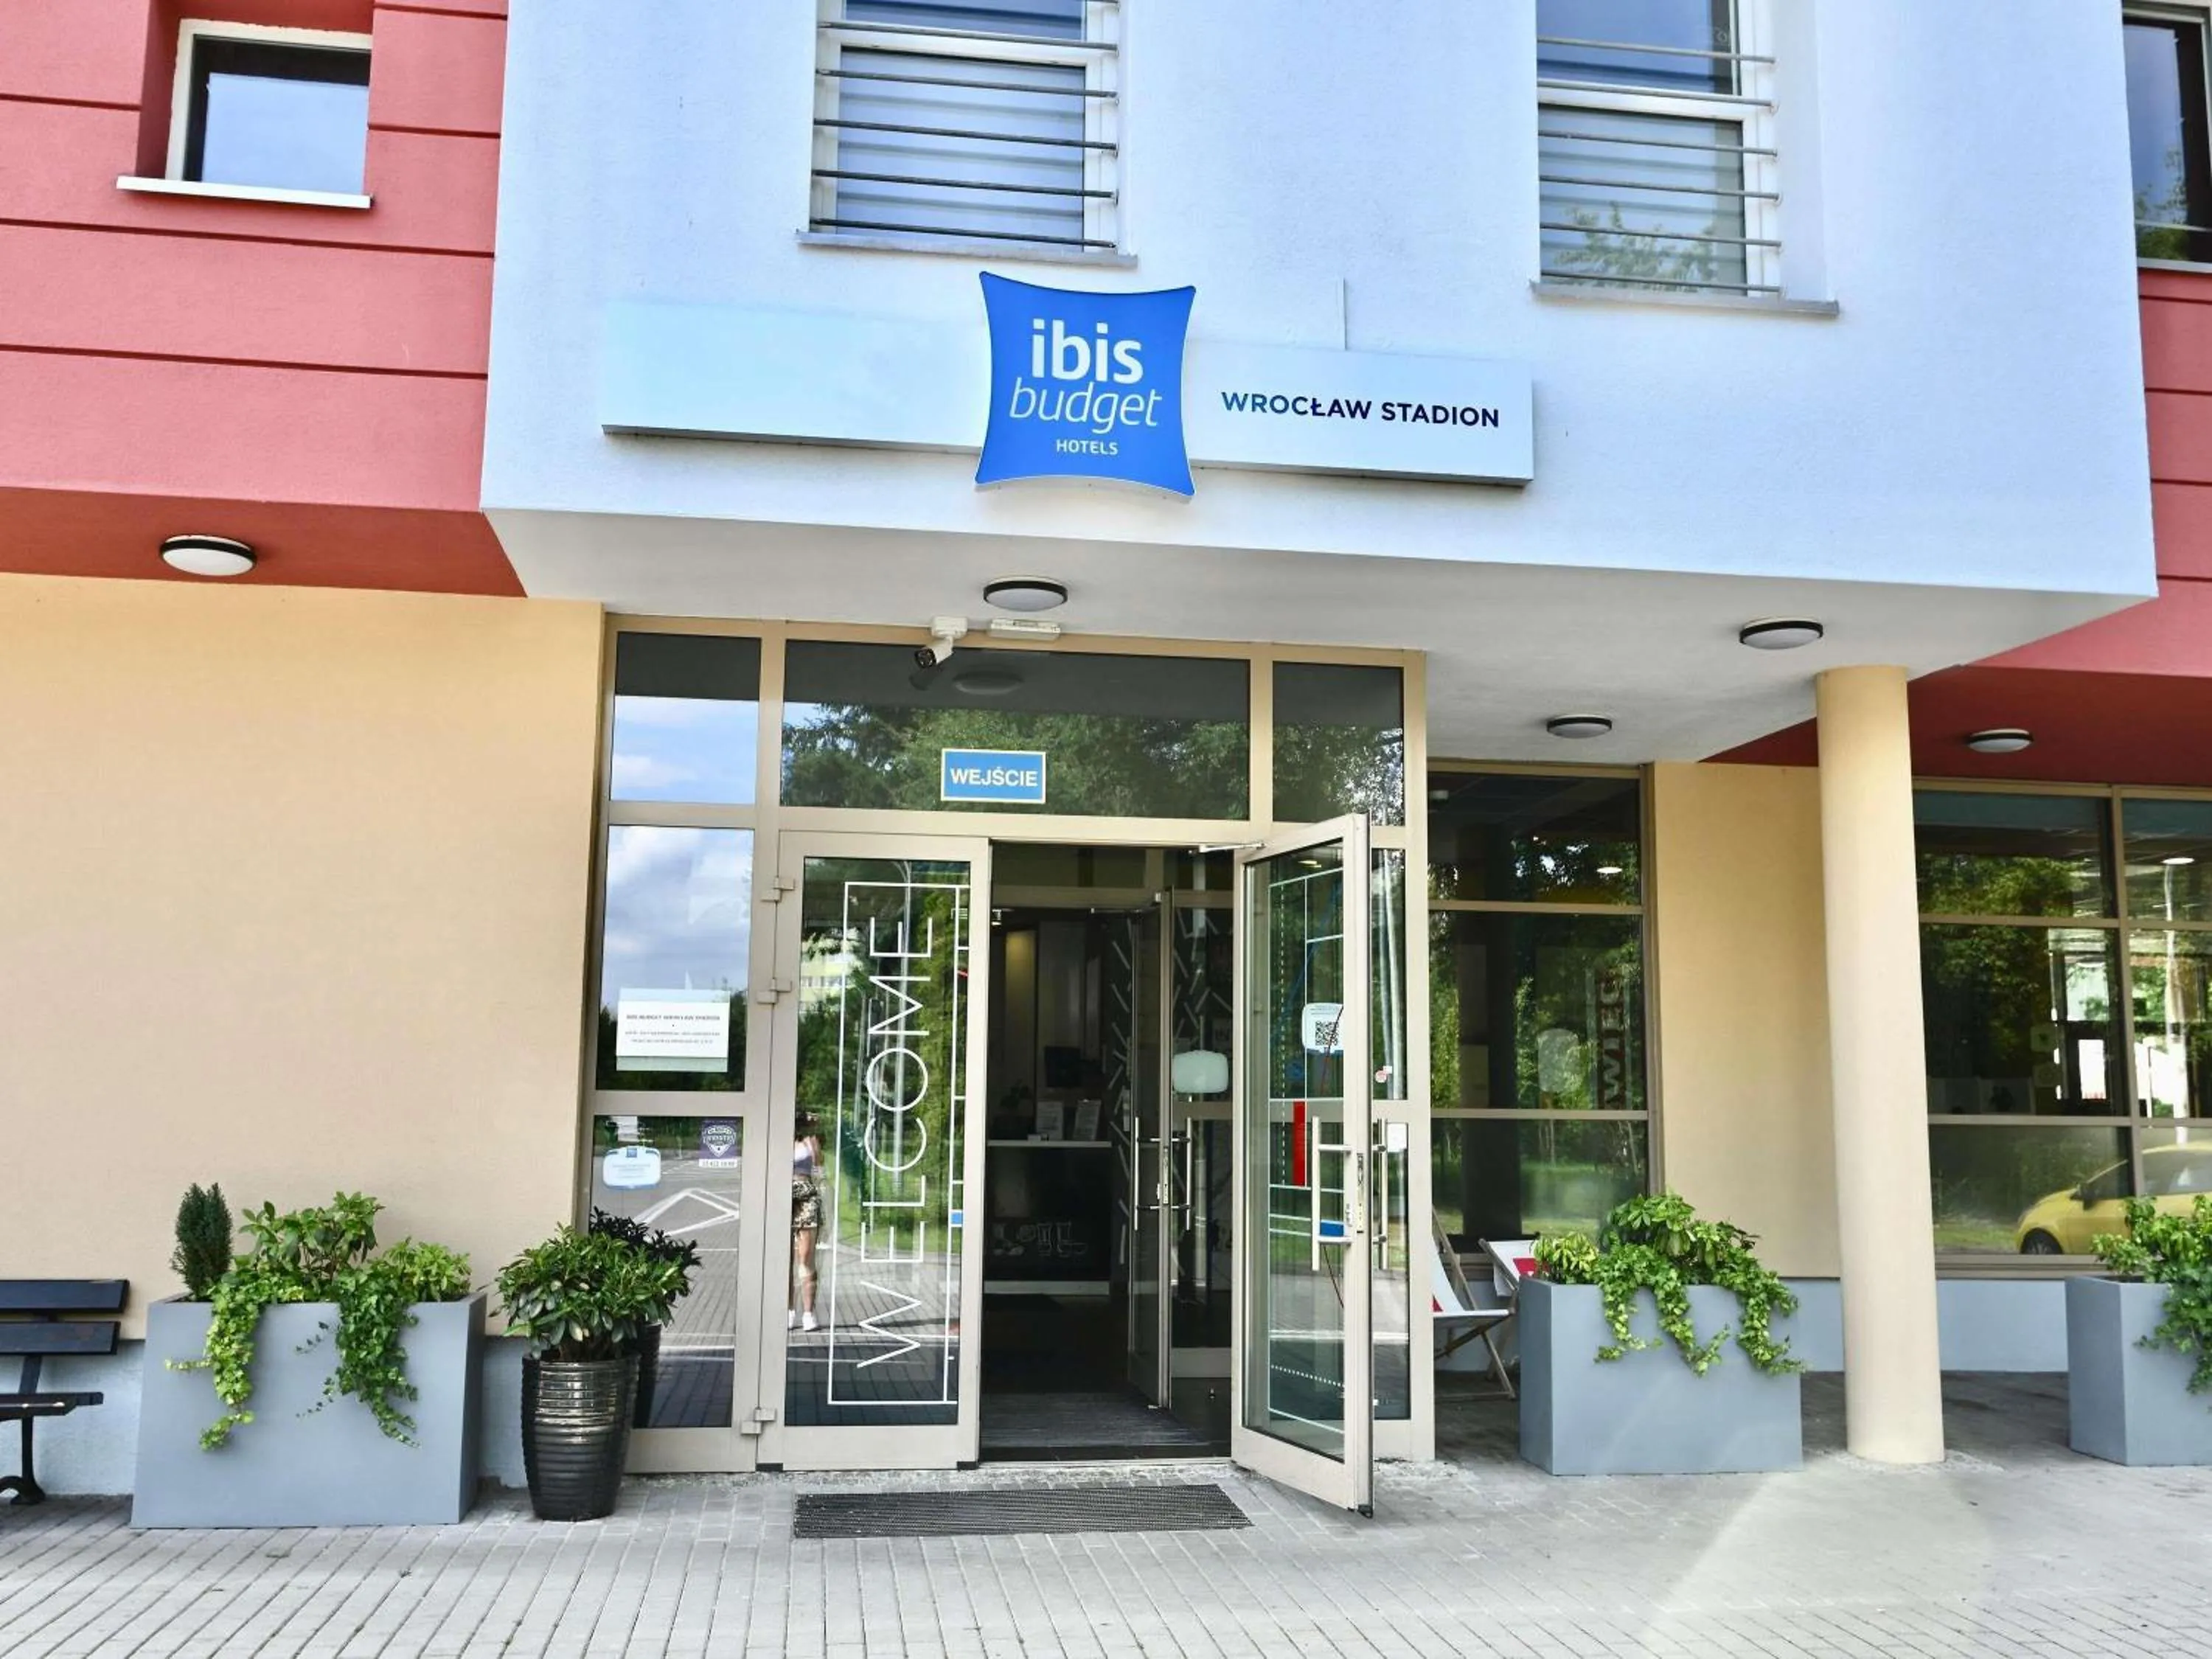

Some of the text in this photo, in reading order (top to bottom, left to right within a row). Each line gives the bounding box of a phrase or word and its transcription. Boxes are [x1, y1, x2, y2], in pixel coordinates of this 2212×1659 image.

[1032, 319, 1144, 384] ibis
[1009, 378, 1163, 435] budget
[1221, 392, 1500, 428] WROCŁAW STADION
[1055, 439, 1119, 456] HOTELS
[950, 765, 1039, 787] WEJŚCIE
[856, 916, 933, 1369] WELCOME
